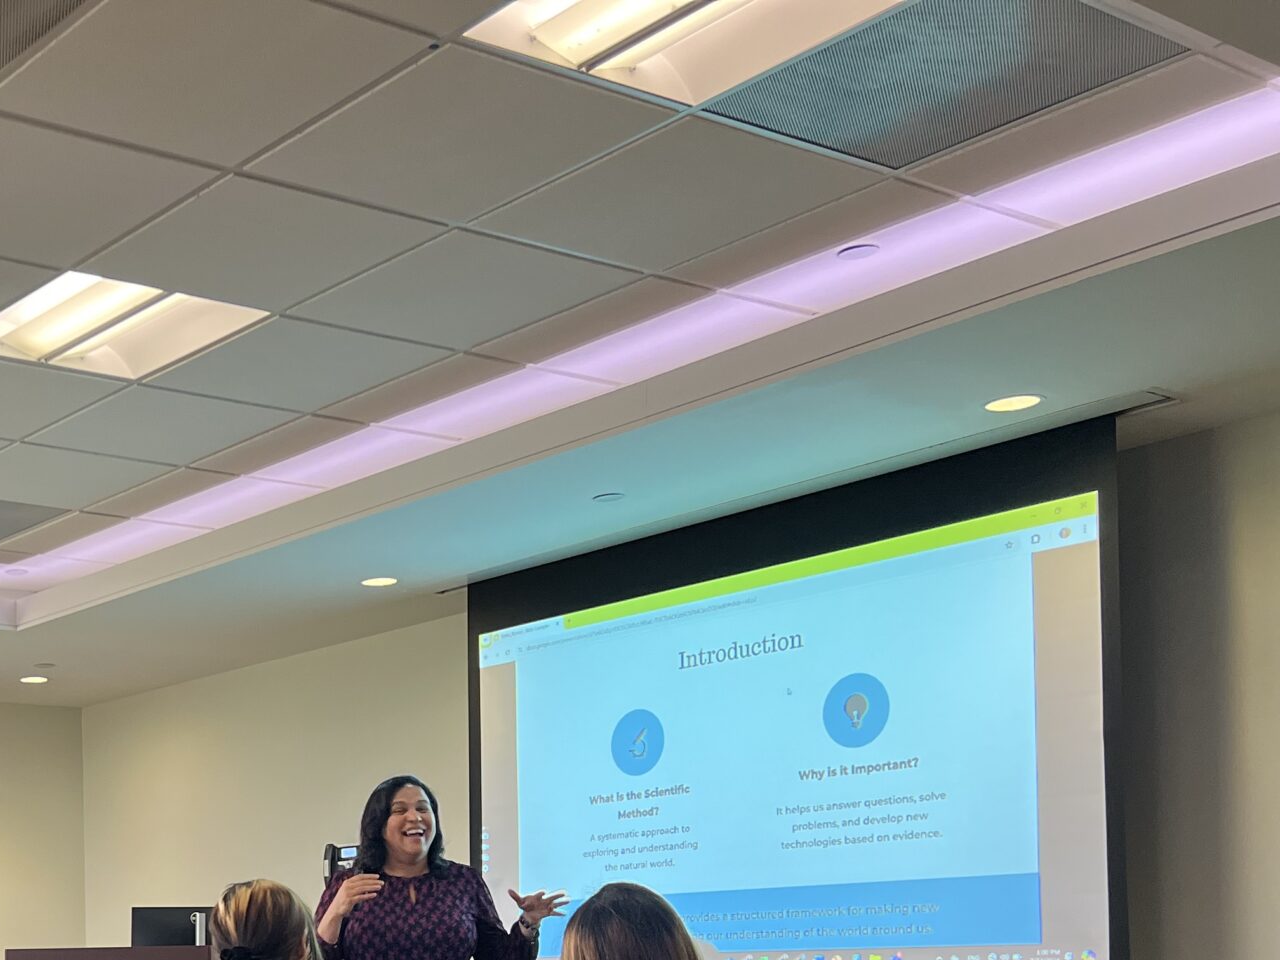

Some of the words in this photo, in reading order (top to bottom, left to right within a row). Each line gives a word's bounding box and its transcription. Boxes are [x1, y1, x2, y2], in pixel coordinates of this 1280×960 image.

[679, 633, 804, 669] Introduction
[799, 769, 824, 780] Why
[828, 767, 837, 777] is
[840, 765, 848, 775] it
[852, 758, 919, 775] Important?
[589, 794, 614, 804] What
[617, 792, 624, 801] is
[626, 791, 642, 800] the
[644, 784, 690, 798] Scientific
[777, 807, 783, 815] It
[785, 805, 811, 815] helps
[813, 803, 824, 812] us
[826, 800, 861, 811] answer
[864, 795, 917, 808] questions,
[919, 791, 946, 802] solve
[618, 807, 659, 819] Method?
[792, 820, 840, 833] problems,
[842, 817, 860, 827] and
[863, 814, 903, 825] develop
[906, 812, 928, 821] new
[598, 830, 639, 842] systematic
[641, 826, 679, 837] approach
[781, 837, 841, 849] technologies
[844, 834, 873, 844] based
[877, 834, 890, 842] on
[892, 830, 943, 841] evidence.
[583, 848, 618, 858] exploring
[621, 846, 636, 854] and
[638, 840, 698, 853] understanding
[605, 863, 618, 871] the
[620, 861, 647, 870] natural
[650, 859, 675, 868] world.
[731, 910, 783, 921] structured
[786, 904, 845, 920] framework
[847, 905, 862, 915] for
[866, 904, 909, 915] making
[912, 904, 939, 912] new
[707, 932, 722, 940] our
[726, 928, 800, 940] understanding
[803, 928, 814, 937] of
[817, 927, 834, 936] the
[838, 925, 868, 936] world
[872, 924, 912, 935] around
